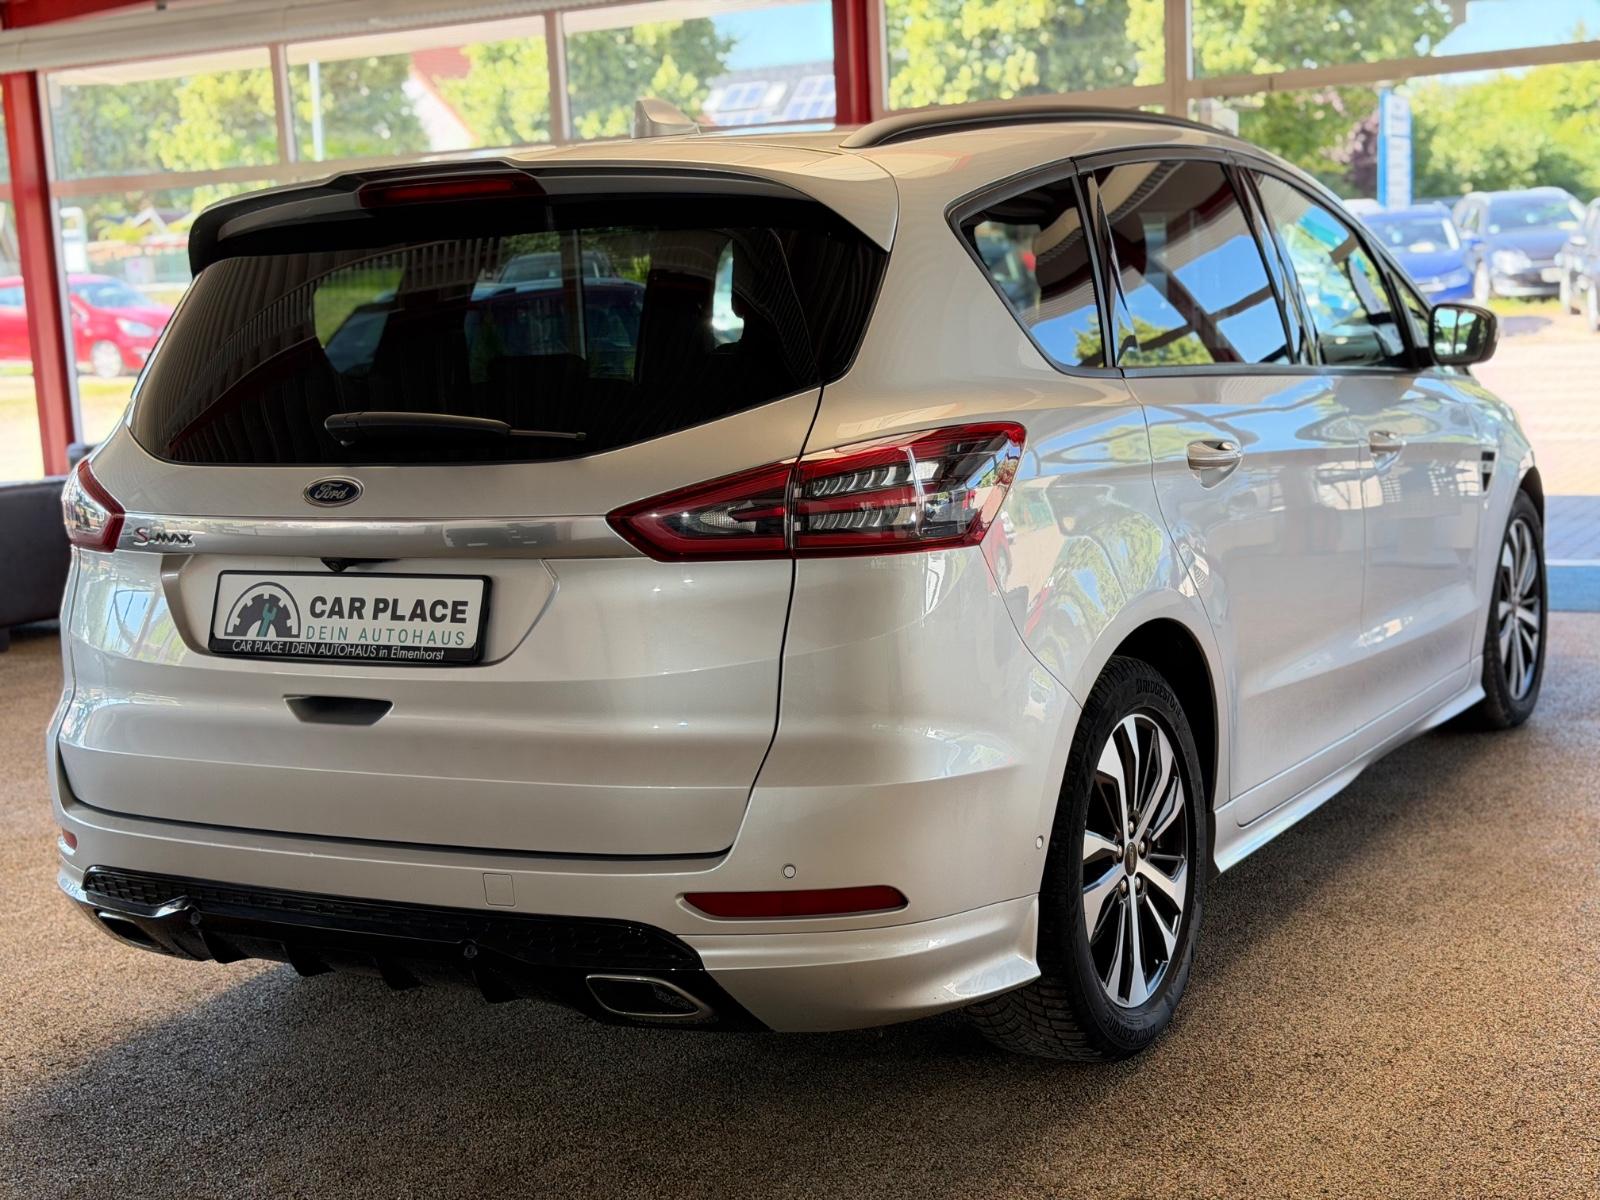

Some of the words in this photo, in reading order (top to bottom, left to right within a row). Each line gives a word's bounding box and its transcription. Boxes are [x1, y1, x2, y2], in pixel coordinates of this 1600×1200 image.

[314, 482, 349, 501] Ford
[309, 596, 367, 620] CAR
[372, 597, 469, 624] PLACE
[306, 625, 349, 641] DEIN
[358, 627, 465, 646] AUTOHAUS
[232, 640, 255, 652] CAR
[255, 640, 284, 653] PLACE
[291, 643, 316, 655] DEIN
[316, 643, 377, 657] AUTOHAUS
[379, 647, 389, 658] in
[391, 646, 445, 660] Elmenhorst
